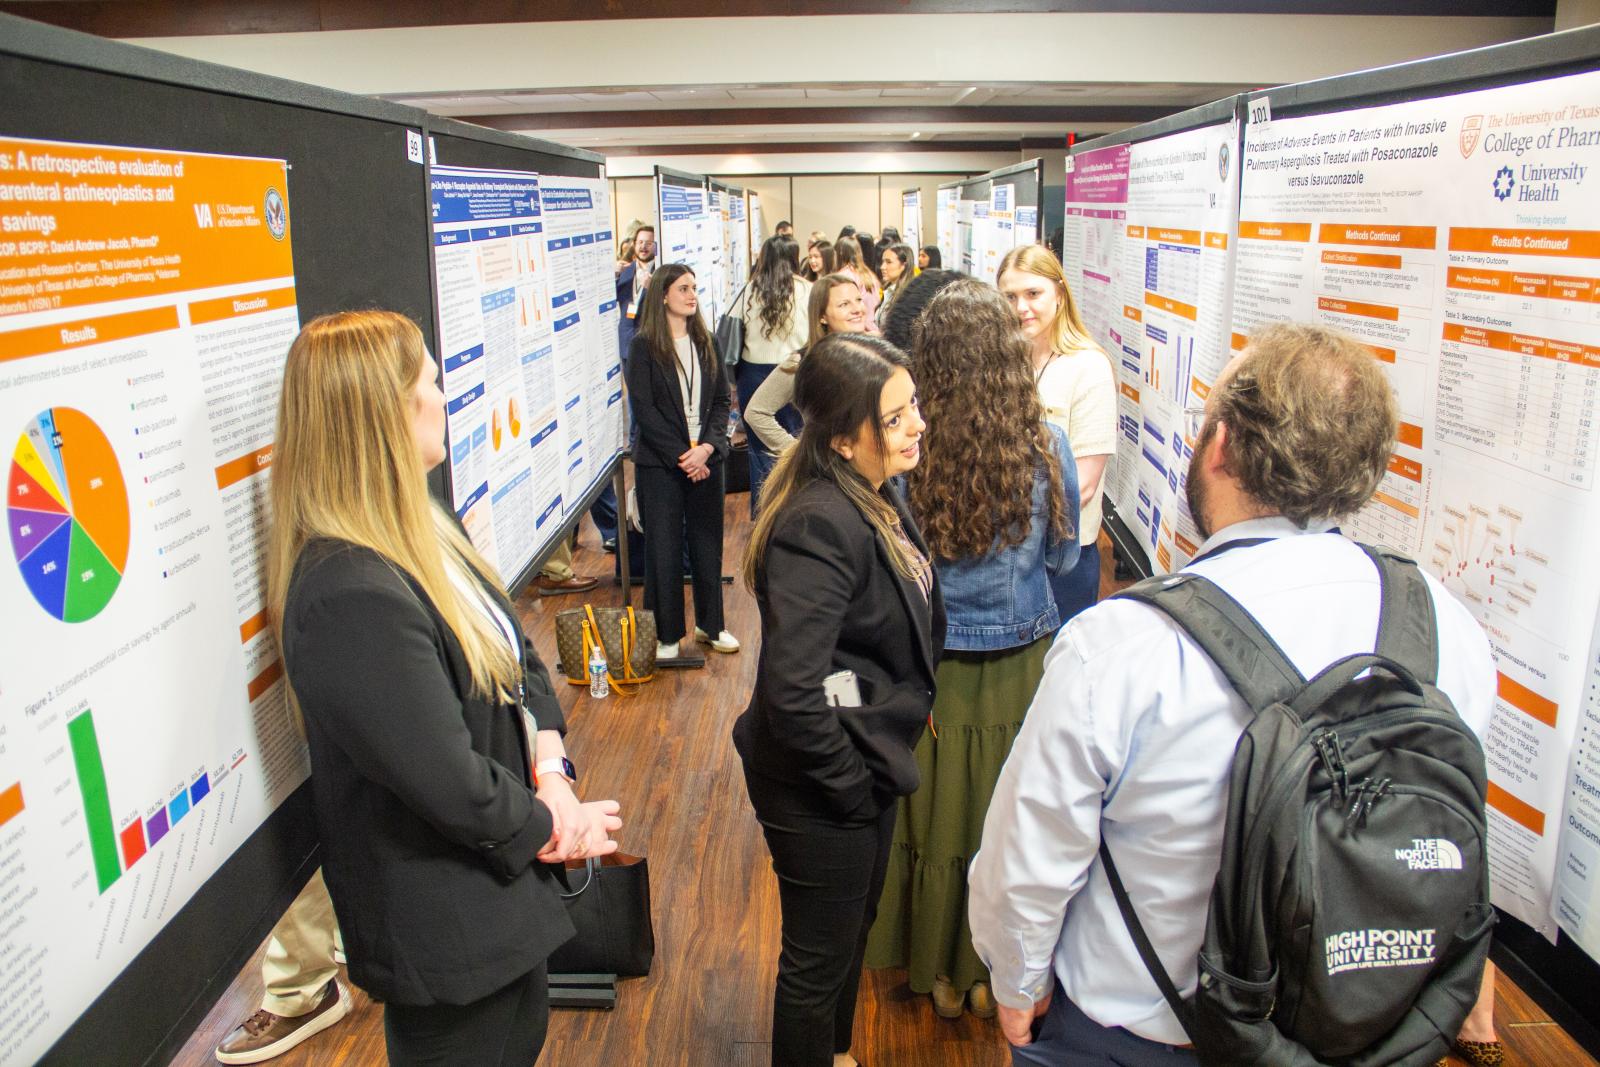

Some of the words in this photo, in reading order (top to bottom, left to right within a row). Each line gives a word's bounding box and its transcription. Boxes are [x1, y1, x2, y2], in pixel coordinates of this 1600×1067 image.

[1252, 106, 1268, 125] 101
[1488, 115, 1502, 128] The
[1504, 110, 1554, 126] University
[1555, 106, 1568, 120] of
[1570, 104, 1600, 120] Texas
[1246, 140, 1276, 153] Incidence
[1284, 135, 1311, 149] Adverse
[1311, 132, 1336, 146] Events
[1338, 130, 1346, 143] in
[1347, 126, 1381, 142] Patients
[1383, 122, 1403, 138] with
[1404, 118, 1447, 136] Invasive
[1484, 132, 1533, 156] College
[1537, 128, 1555, 149] of
[17, 150, 28, 171] A
[30, 152, 117, 177] retrospective
[119, 158, 172, 177] evaluation
[173, 161, 184, 177] of
[1246, 157, 1280, 172] Pulmonary
[1323, 150, 1349, 165] Treated
[1351, 148, 1369, 163] with
[1371, 142, 1438, 161] Posaconazole
[1288, 174, 1308, 187] versus
[1310, 170, 1364, 186] Isavuconazole
[1521, 162, 1588, 185] University
[63, 182, 153, 206] antineoplastics
[156, 185, 174, 201] and
[1518, 184, 1559, 202] Health
[2, 211, 57, 236] savings
[194, 204, 213, 228] VA
[1516, 214, 1541, 226] Thinking
[1542, 214, 1567, 226] beyond
[1345, 229, 1369, 241] Methods
[1369, 230, 1401, 243] Continued
[1491, 234, 1521, 248] Results
[1523, 237, 1569, 250] Continued
[51, 240, 74, 253] David
[42, 262, 74, 275] Research
[1467, 256, 1485, 265] Primary
[1486, 257, 1509, 266] Outcome
[52, 296, 61, 307] 17
[1462, 313, 1485, 325] Secondary
[1486, 316, 1511, 328] Outcomes
[60, 326, 97, 345] Results
[24, 698, 47, 718] Figure
[89, 651, 117, 678] potential
[1412, 839, 1438, 850] THE
[1395, 849, 1438, 860] NORTH
[1408, 859, 1440, 870] FACE
[1326, 929, 1365, 954] HIGH
[1368, 928, 1436, 947] POINT
[1327, 944, 1436, 968] UNIVERSITY
